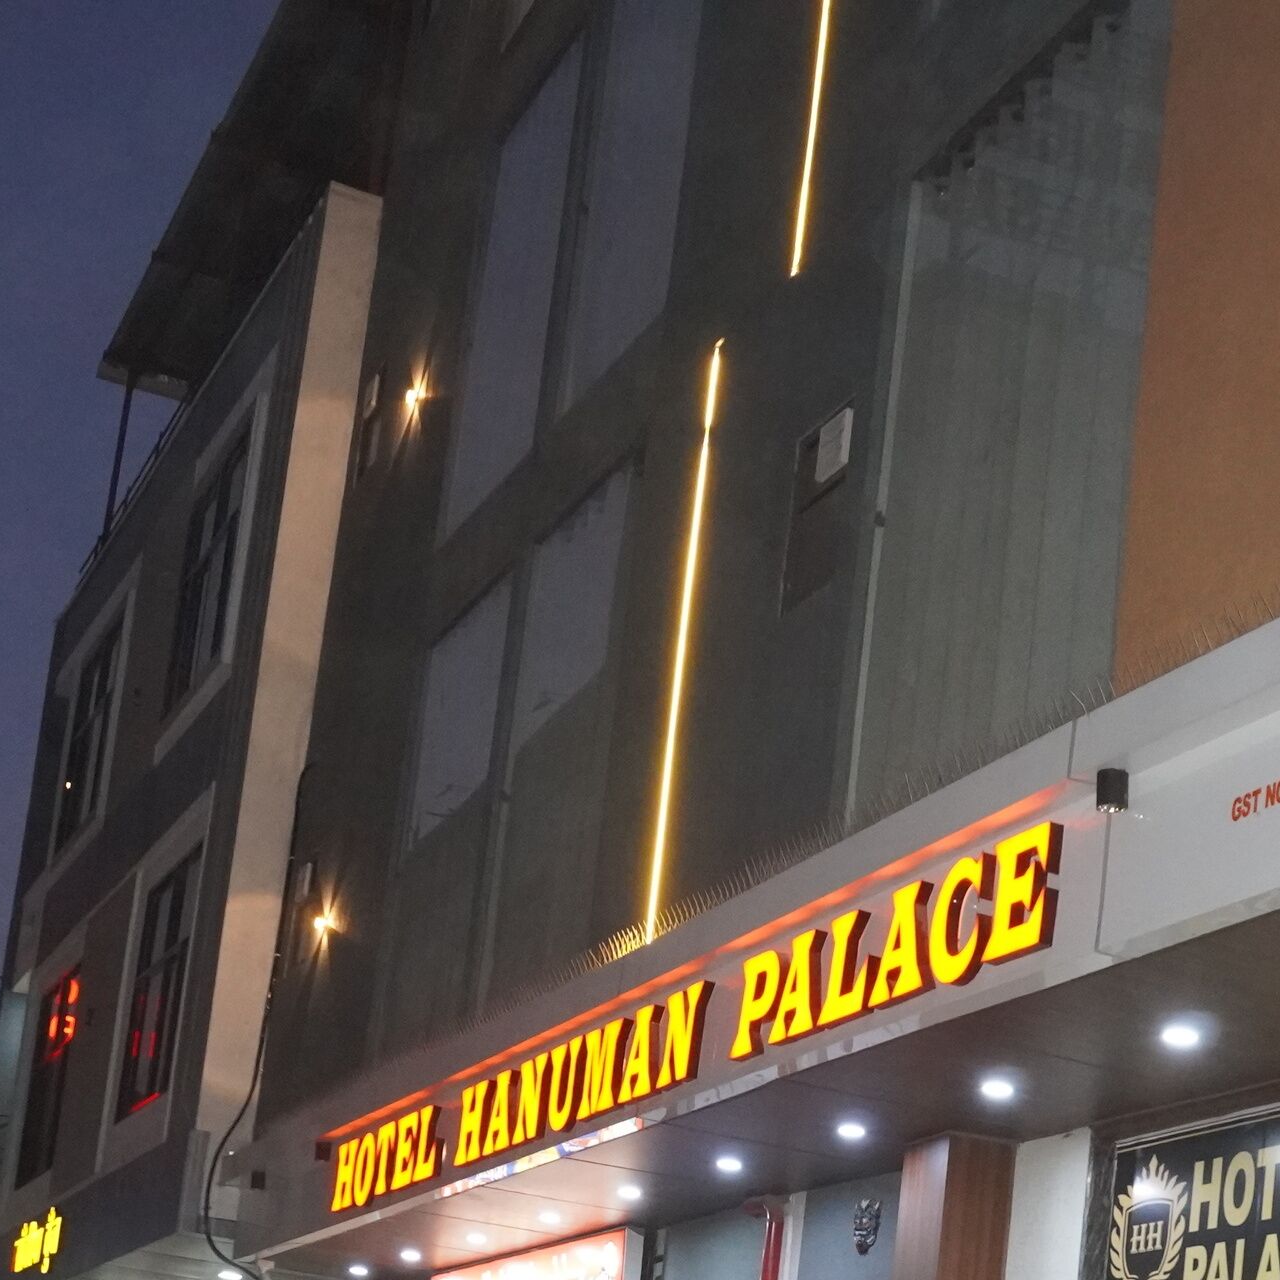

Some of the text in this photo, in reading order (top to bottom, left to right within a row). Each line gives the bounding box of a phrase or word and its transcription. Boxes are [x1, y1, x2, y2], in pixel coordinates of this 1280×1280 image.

[1231, 788, 1262, 822] GST
[331, 820, 1064, 1213] HOTEL HANUMAN PALACE
